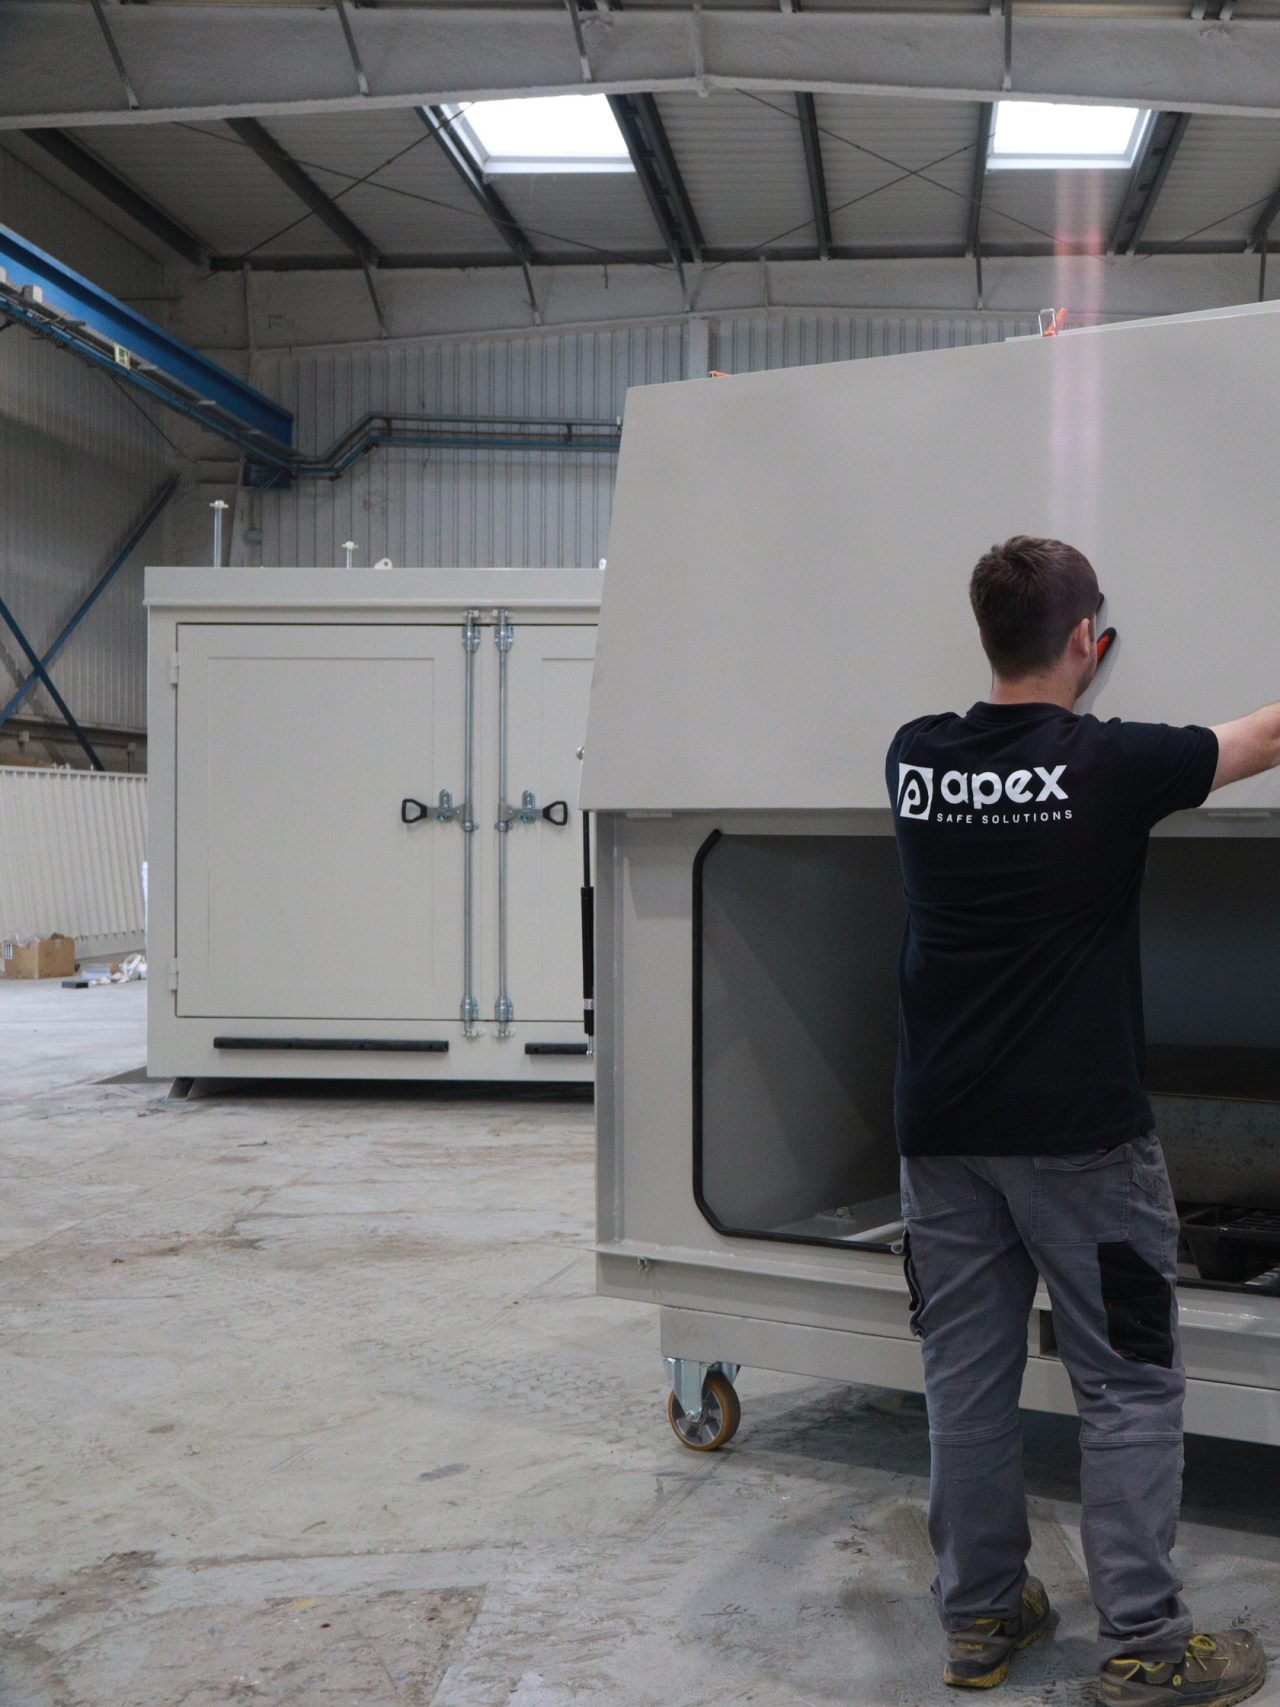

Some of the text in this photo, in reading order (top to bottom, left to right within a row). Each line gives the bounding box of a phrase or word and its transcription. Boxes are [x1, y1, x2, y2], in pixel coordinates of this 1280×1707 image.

[940, 765, 1069, 809] apex
[936, 810, 1073, 824] SAFE SOLUTIONS
